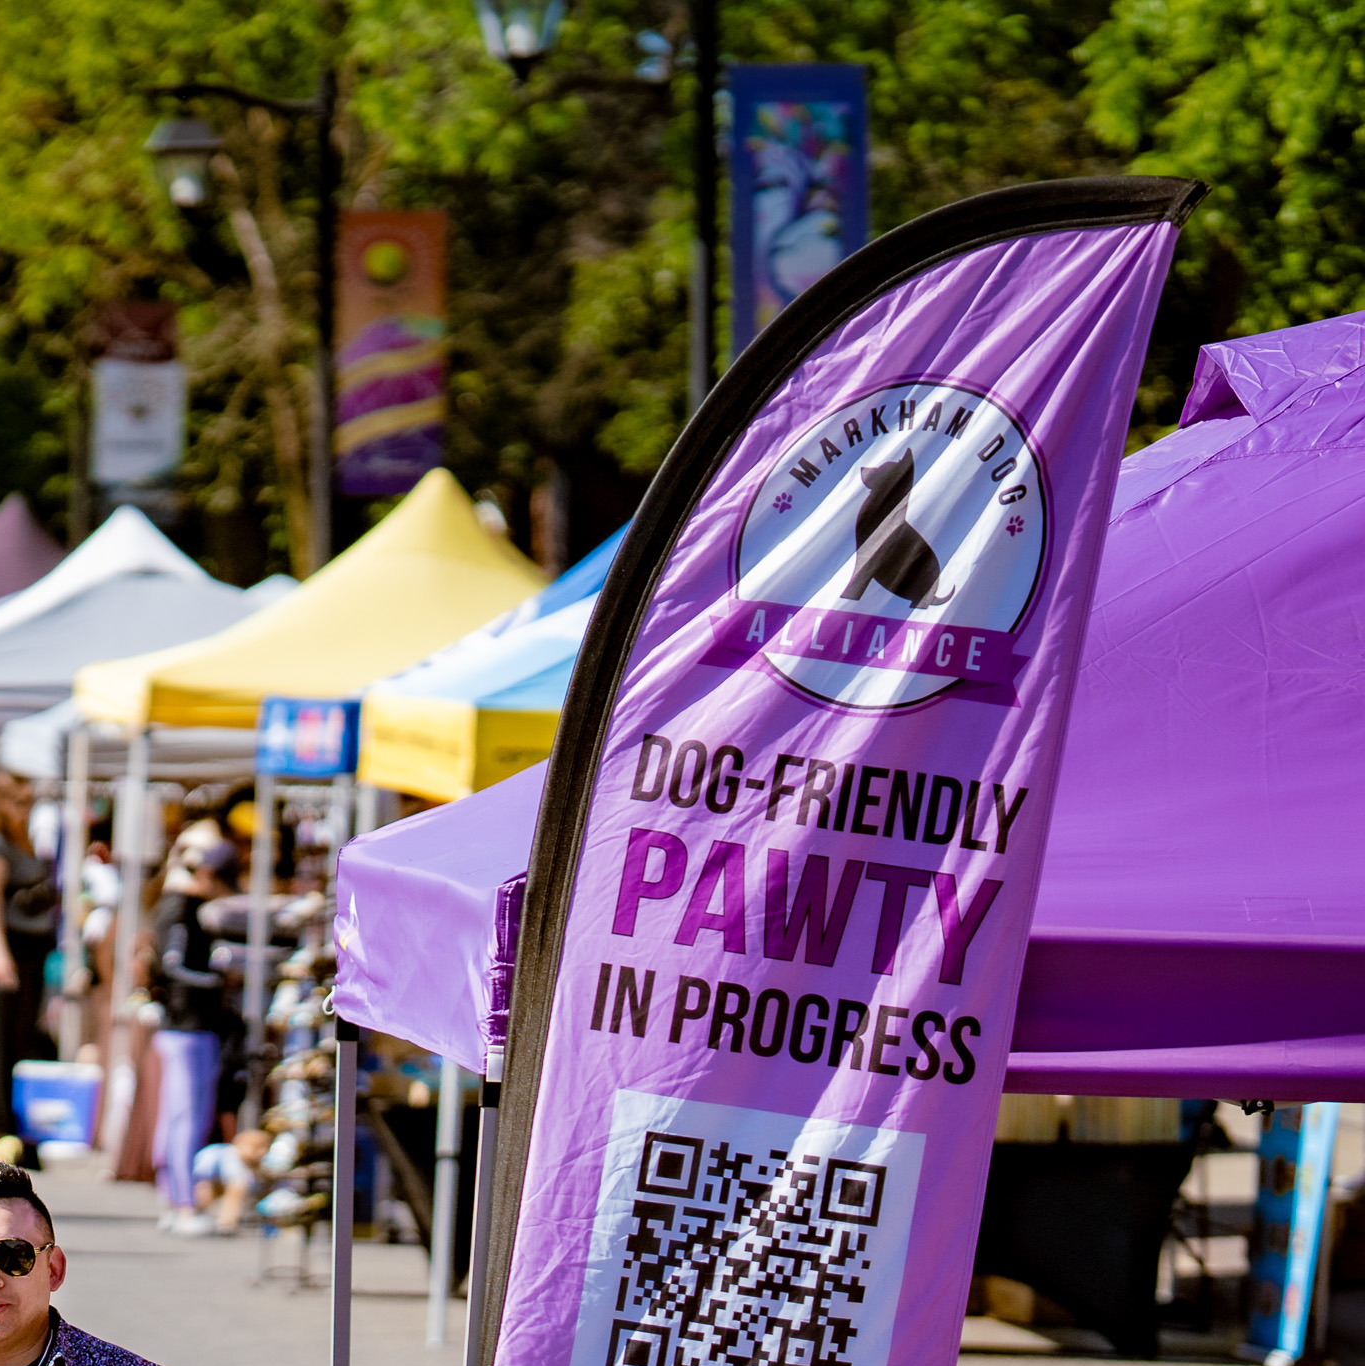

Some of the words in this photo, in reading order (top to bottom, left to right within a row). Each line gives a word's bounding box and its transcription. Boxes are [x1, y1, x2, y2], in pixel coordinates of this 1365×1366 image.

[789, 399, 975, 489] MARKHAM
[977, 432, 1029, 507] DOG
[746, 608, 989, 672] ALLIANCE
[629, 733, 1029, 855] DOG-FRIENDLY
[610, 826, 1004, 987] PAWTY
[589, 962, 657, 1039] IN
[668, 976, 982, 1086] PROGRESS
